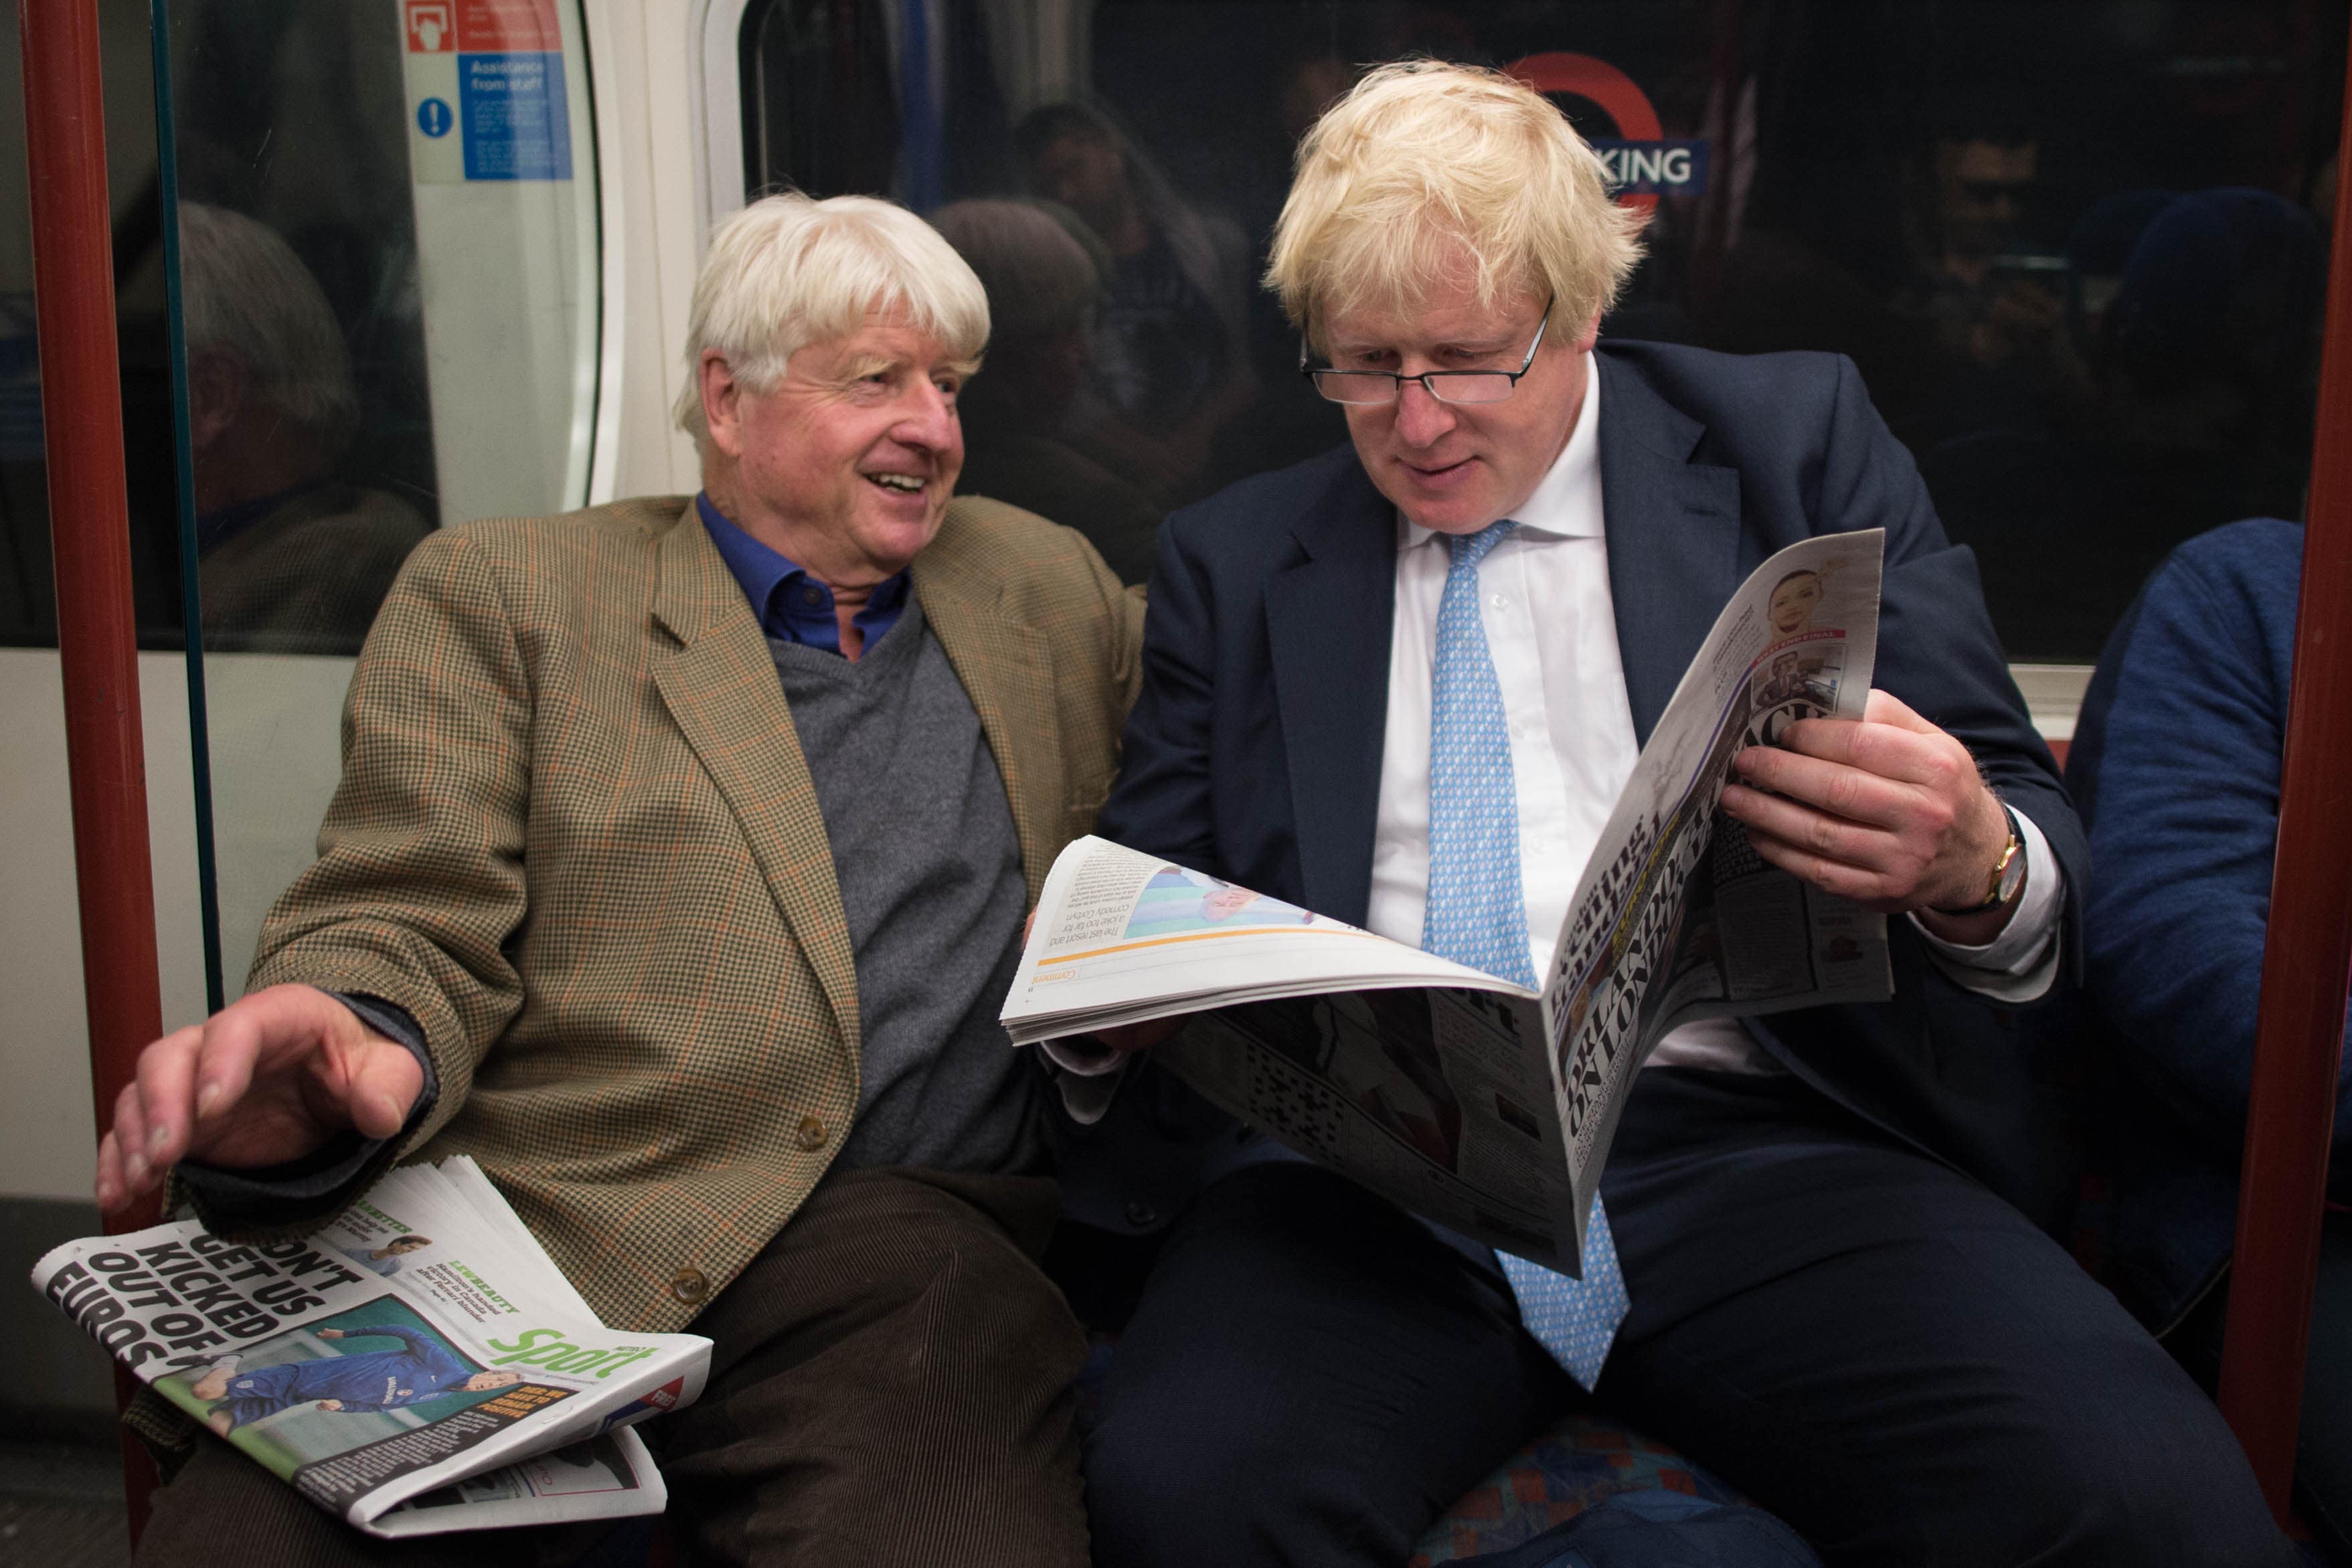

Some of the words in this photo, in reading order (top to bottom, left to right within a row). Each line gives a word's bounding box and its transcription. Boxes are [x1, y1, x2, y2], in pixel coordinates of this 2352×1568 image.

[471, 78, 505, 91] from
[509, 78, 542, 91] staff
[1596, 147, 1691, 184] KING
[1062, 924, 1074, 933] for
[1066, 909, 1095, 922] Corbyn
[1075, 922, 1086, 932] far
[1086, 920, 1099, 929] too
[1095, 903, 1130, 918] comedy
[1100, 916, 1120, 927] joke
[1550, 814, 1645, 1012] Evening
[1553, 810, 1659, 1031] Standard
[1049, 936, 1066, 948] and
[1065, 932, 1090, 944] resort
[1089, 929, 1103, 940] last
[1104, 926, 1120, 936] The
[1031, 969, 1076, 985] Comment
[1570, 1053, 1603, 1138] ON
[1600, 869, 1685, 1069] LONDON
[189, 1234, 280, 1282] GET
[252, 1279, 327, 1316] US
[258, 1240, 365, 1292] ON'T
[88, 1251, 183, 1308] OUT
[150, 1312, 229, 1352] OF
[135, 1241, 280, 1338] KICKED
[415, 1268, 436, 1281] after
[433, 1280, 461, 1300] Ferrari
[456, 1300, 487, 1323] blunder
[427, 1265, 454, 1284] victory
[459, 1292, 487, 1314] Canada
[436, 1264, 475, 1293] Hamilton's
[472, 1292, 502, 1315] handed
[448, 1260, 520, 1313] LEWBEAUTY
[46, 1260, 170, 1369] EUROS
[486, 1328, 660, 1379] Sport
[651, 1389, 677, 1407] FREE
